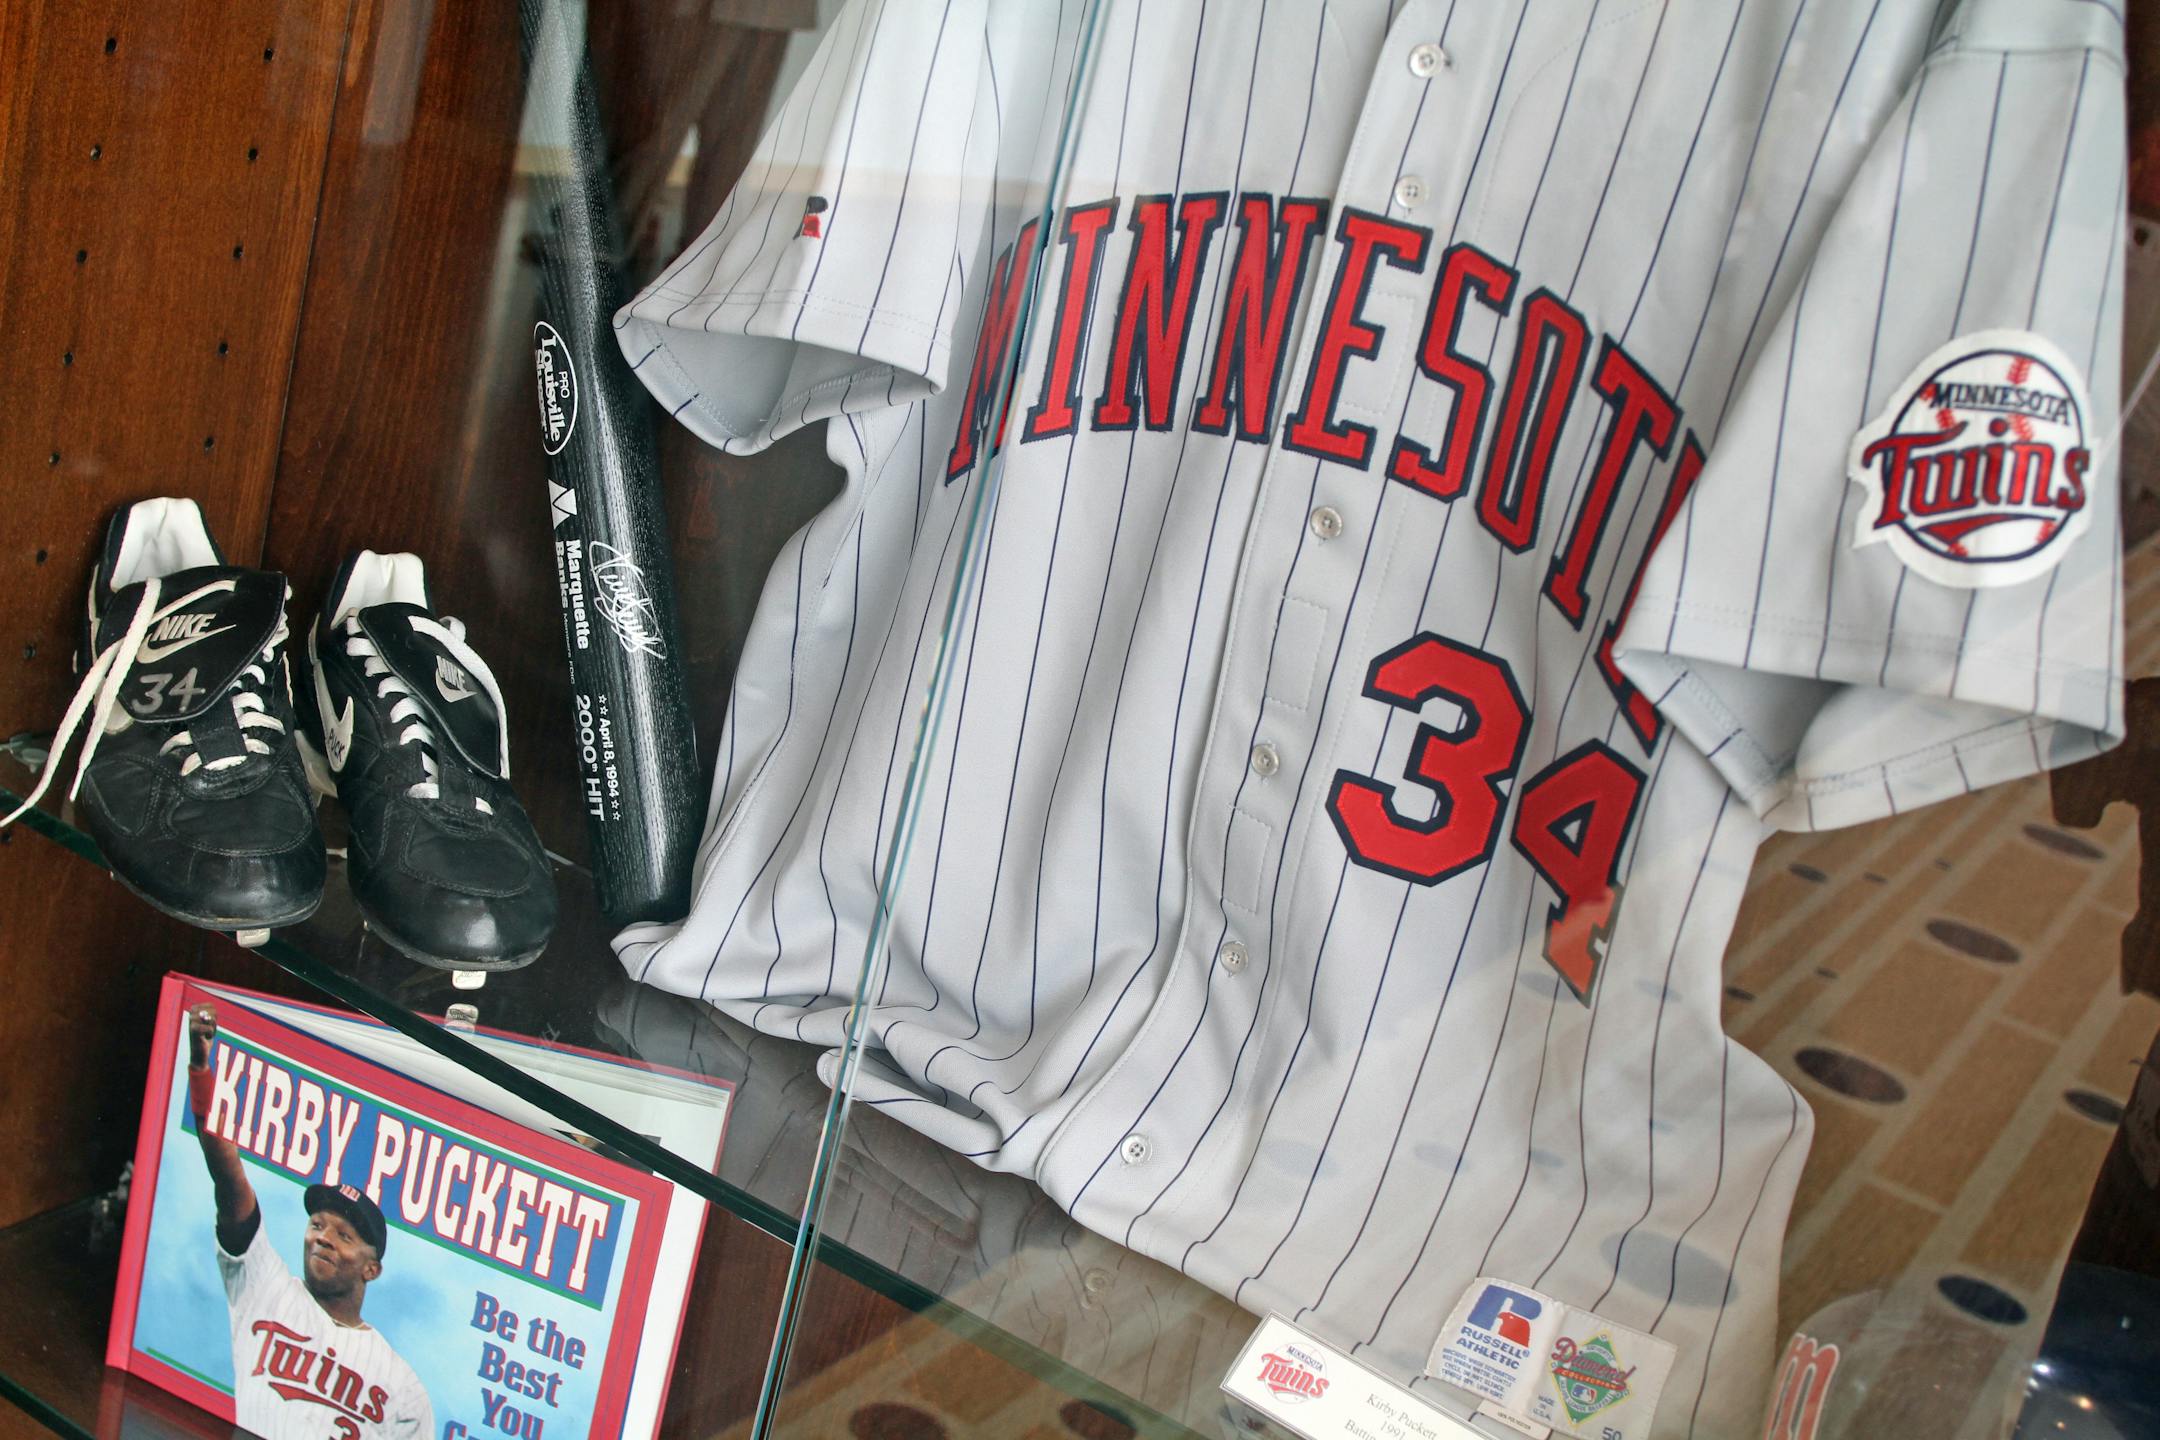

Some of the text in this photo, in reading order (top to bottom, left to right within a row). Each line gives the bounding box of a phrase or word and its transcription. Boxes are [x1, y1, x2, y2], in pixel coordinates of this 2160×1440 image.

[541, 335, 566, 442] Louisville
[559, 370, 570, 398] PRO
[1929, 381, 2070, 426] MINNESOTA
[1861, 418, 2091, 530] Twins
[555, 541, 569, 608] Banks
[565, 539, 590, 650] Marquette
[149, 613, 216, 641] NIKE
[131, 667, 206, 713] 34
[576, 694, 605, 821] 2000th HIT
[599, 718, 619, 798] April 8, 1994
[1325, 631, 1648, 1009] 34
[204, 1042, 611, 1293] KIRBY PUCKETT
[470, 1290, 587, 1371] Be the
[1456, 1337, 1520, 1370] ATHLETIC
[251, 1320, 389, 1424] Twins
[477, 1341, 563, 1409] Best
[1257, 1351, 1330, 1399] Twins
[481, 1387, 545, 1440] You
[1366, 1393, 1438, 1440] Kirby Puckett
[1602, 1426, 1622, 1440] 50
